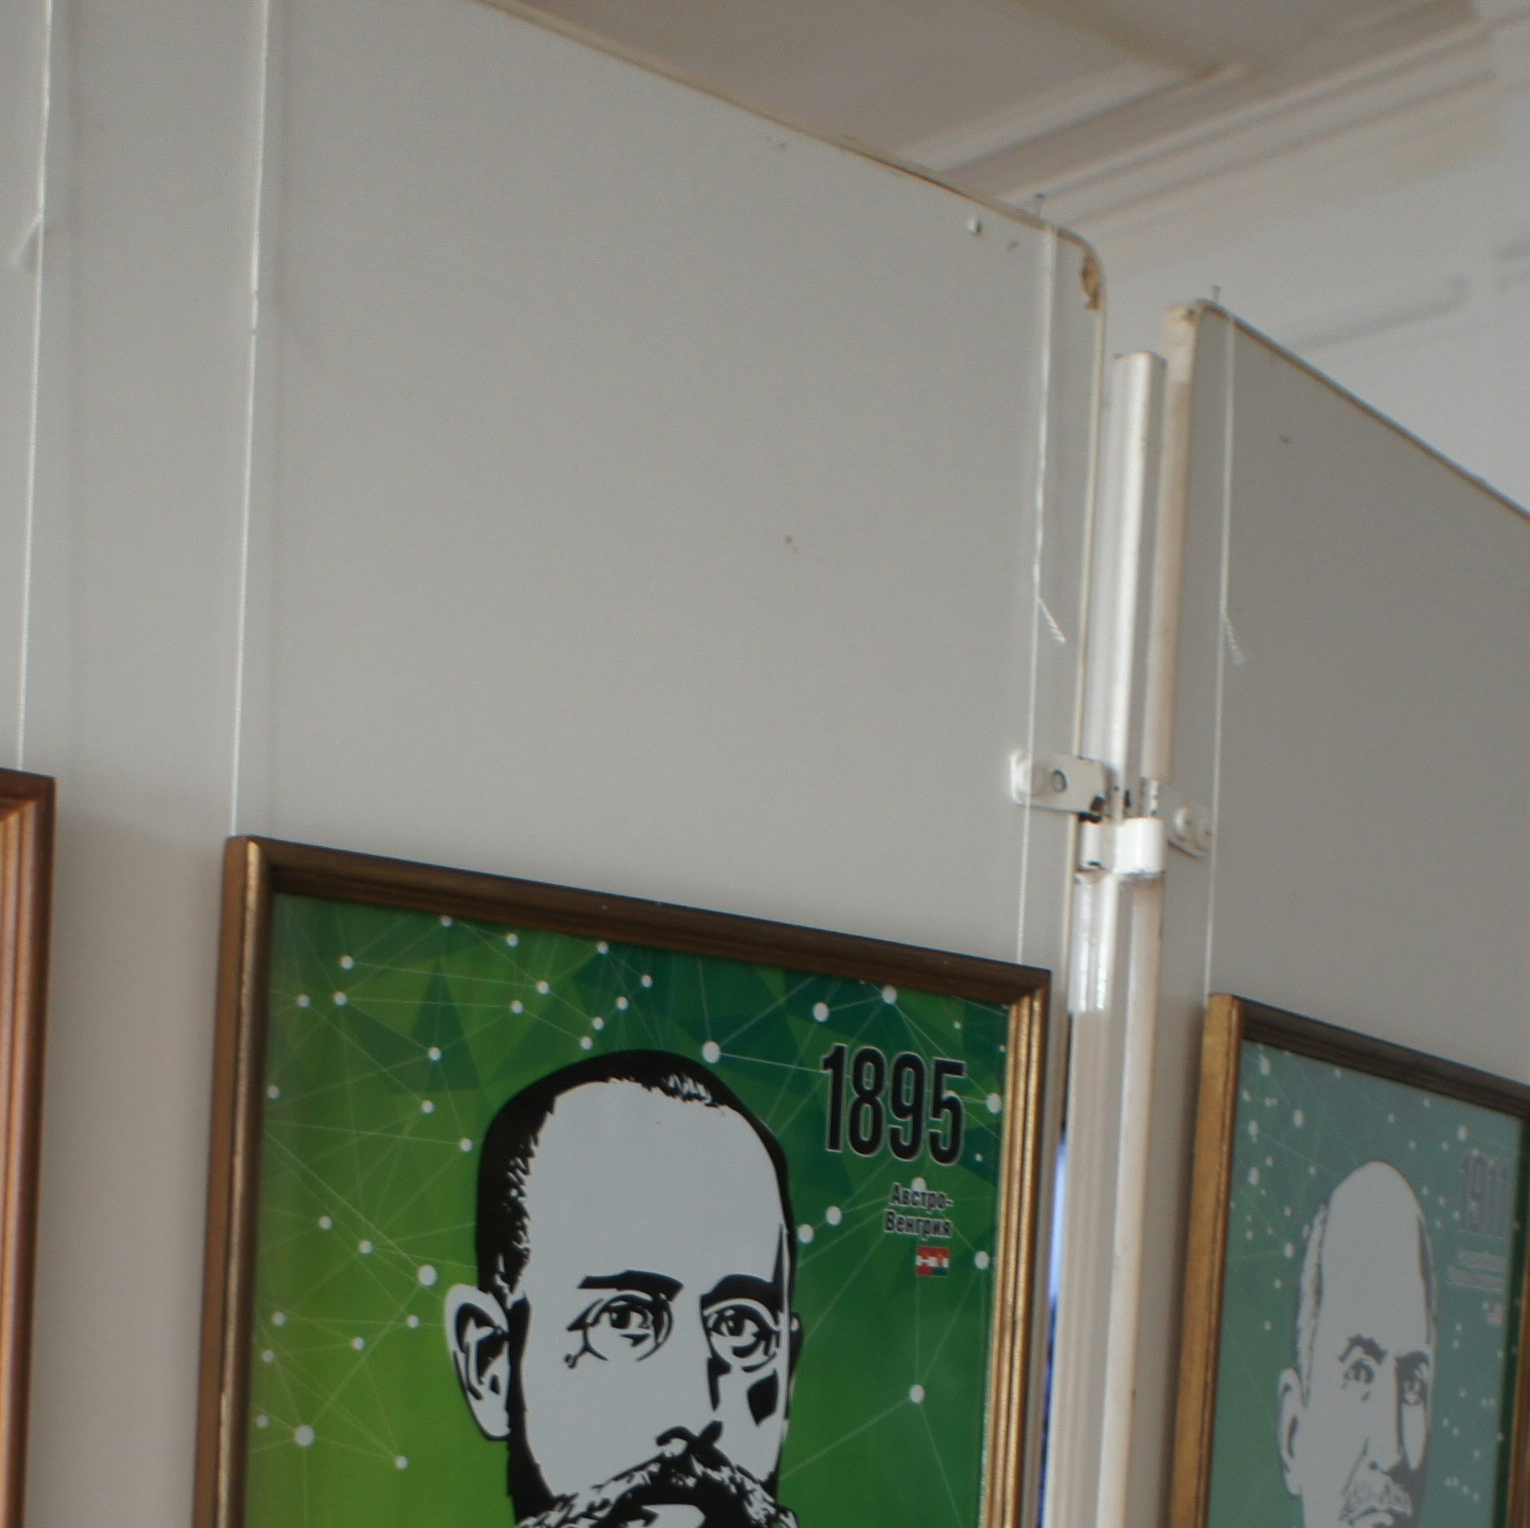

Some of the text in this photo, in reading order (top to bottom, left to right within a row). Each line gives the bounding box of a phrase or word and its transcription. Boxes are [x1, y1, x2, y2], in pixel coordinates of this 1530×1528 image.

[823, 1043, 966, 1165] 1895
[889, 1183, 953, 1211] Австро-
[884, 1209, 952, 1239] Венгрия
